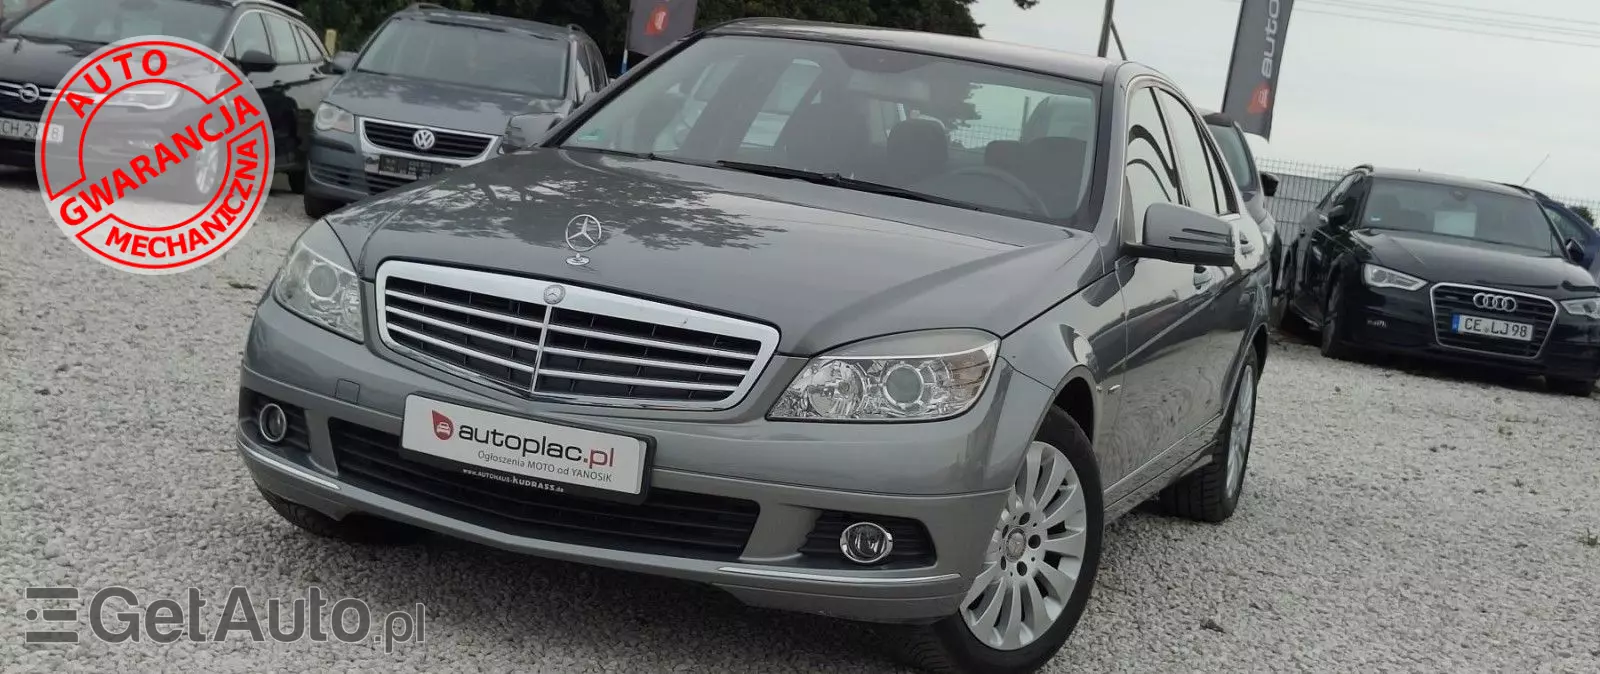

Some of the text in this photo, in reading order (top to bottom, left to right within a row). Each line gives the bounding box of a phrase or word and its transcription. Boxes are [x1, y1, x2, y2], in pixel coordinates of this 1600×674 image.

[1260, 0, 1280, 78] auto
[1464, 318, 1482, 331] CE
[459, 426, 615, 469] autoplac.pl
[477, 450, 525, 468] Ogłoszenia
[527, 459, 555, 474] MOTO
[557, 465, 569, 476] od
